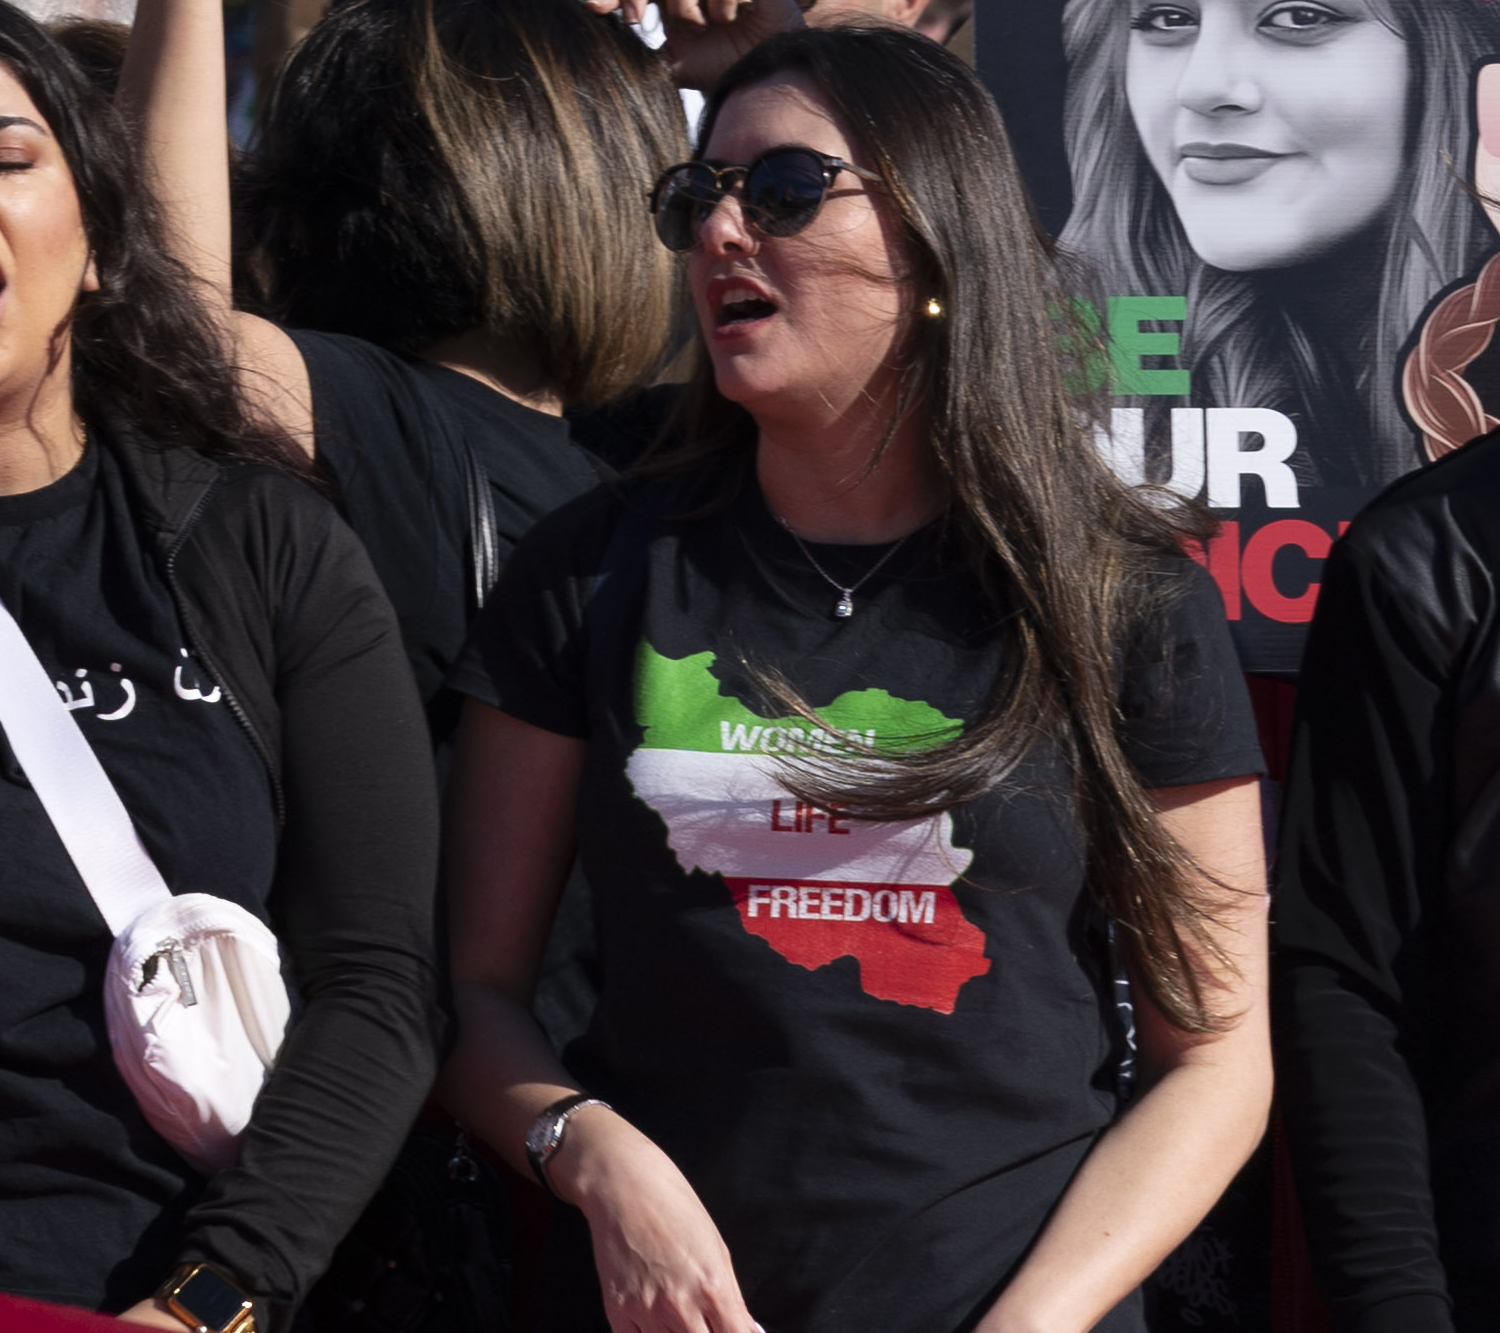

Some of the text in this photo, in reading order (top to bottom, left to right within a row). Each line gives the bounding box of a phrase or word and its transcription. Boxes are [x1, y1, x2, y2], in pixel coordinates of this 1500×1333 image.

[1076, 406, 1301, 510] UR
[719, 720, 877, 753] WOMEN
[770, 799, 851, 835] LIFE
[747, 884, 937, 925] FREEDOM
